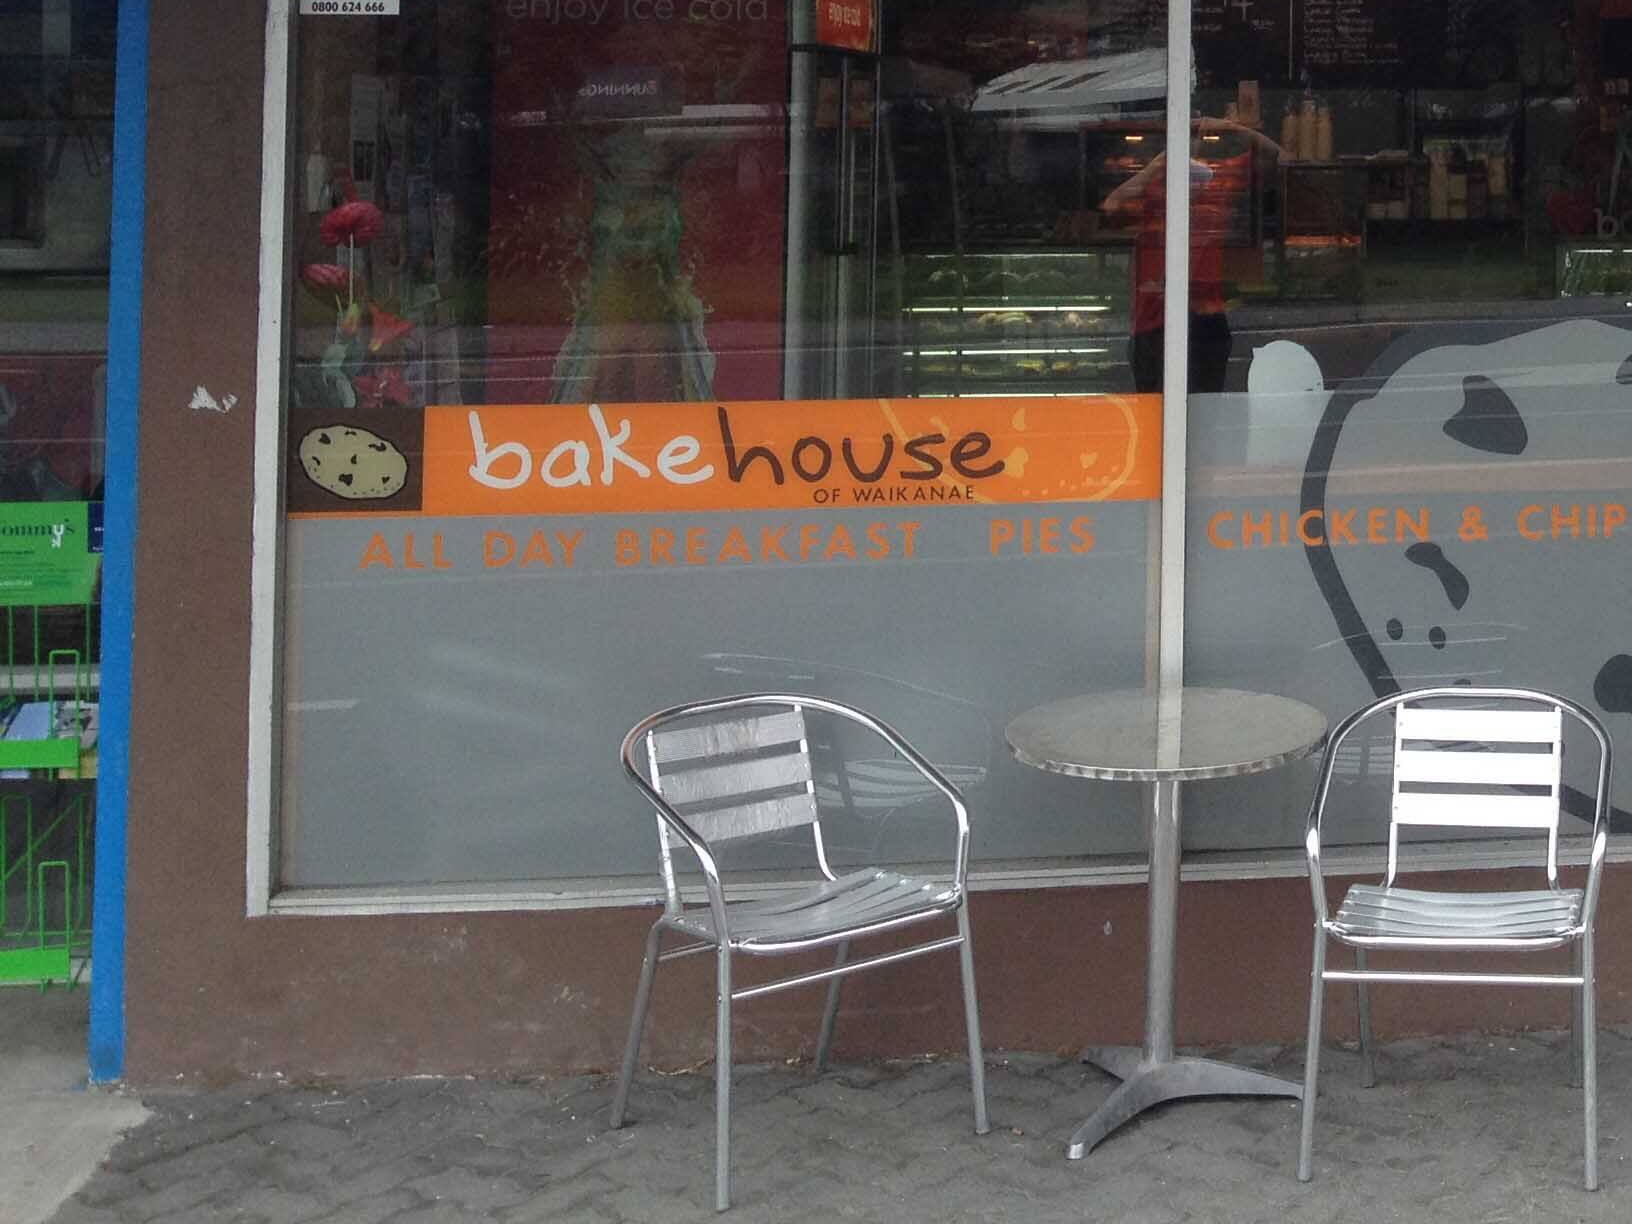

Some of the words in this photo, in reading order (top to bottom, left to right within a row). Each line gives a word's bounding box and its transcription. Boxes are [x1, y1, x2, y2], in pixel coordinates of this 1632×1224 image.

[311, 1, 339, 13] 0800
[342, 1, 362, 13] 624
[364, 1, 385, 13] 666
[813, 488, 842, 504] OF
[852, 484, 976, 502] WAIKANAE
[359, 531, 450, 570] ALL
[481, 528, 585, 569] DAY
[615, 519, 923, 566] BREAKFAST
[987, 514, 1098, 555] PIES
[1206, 508, 1430, 551] CHICKEN
[1459, 507, 1490, 542] &
